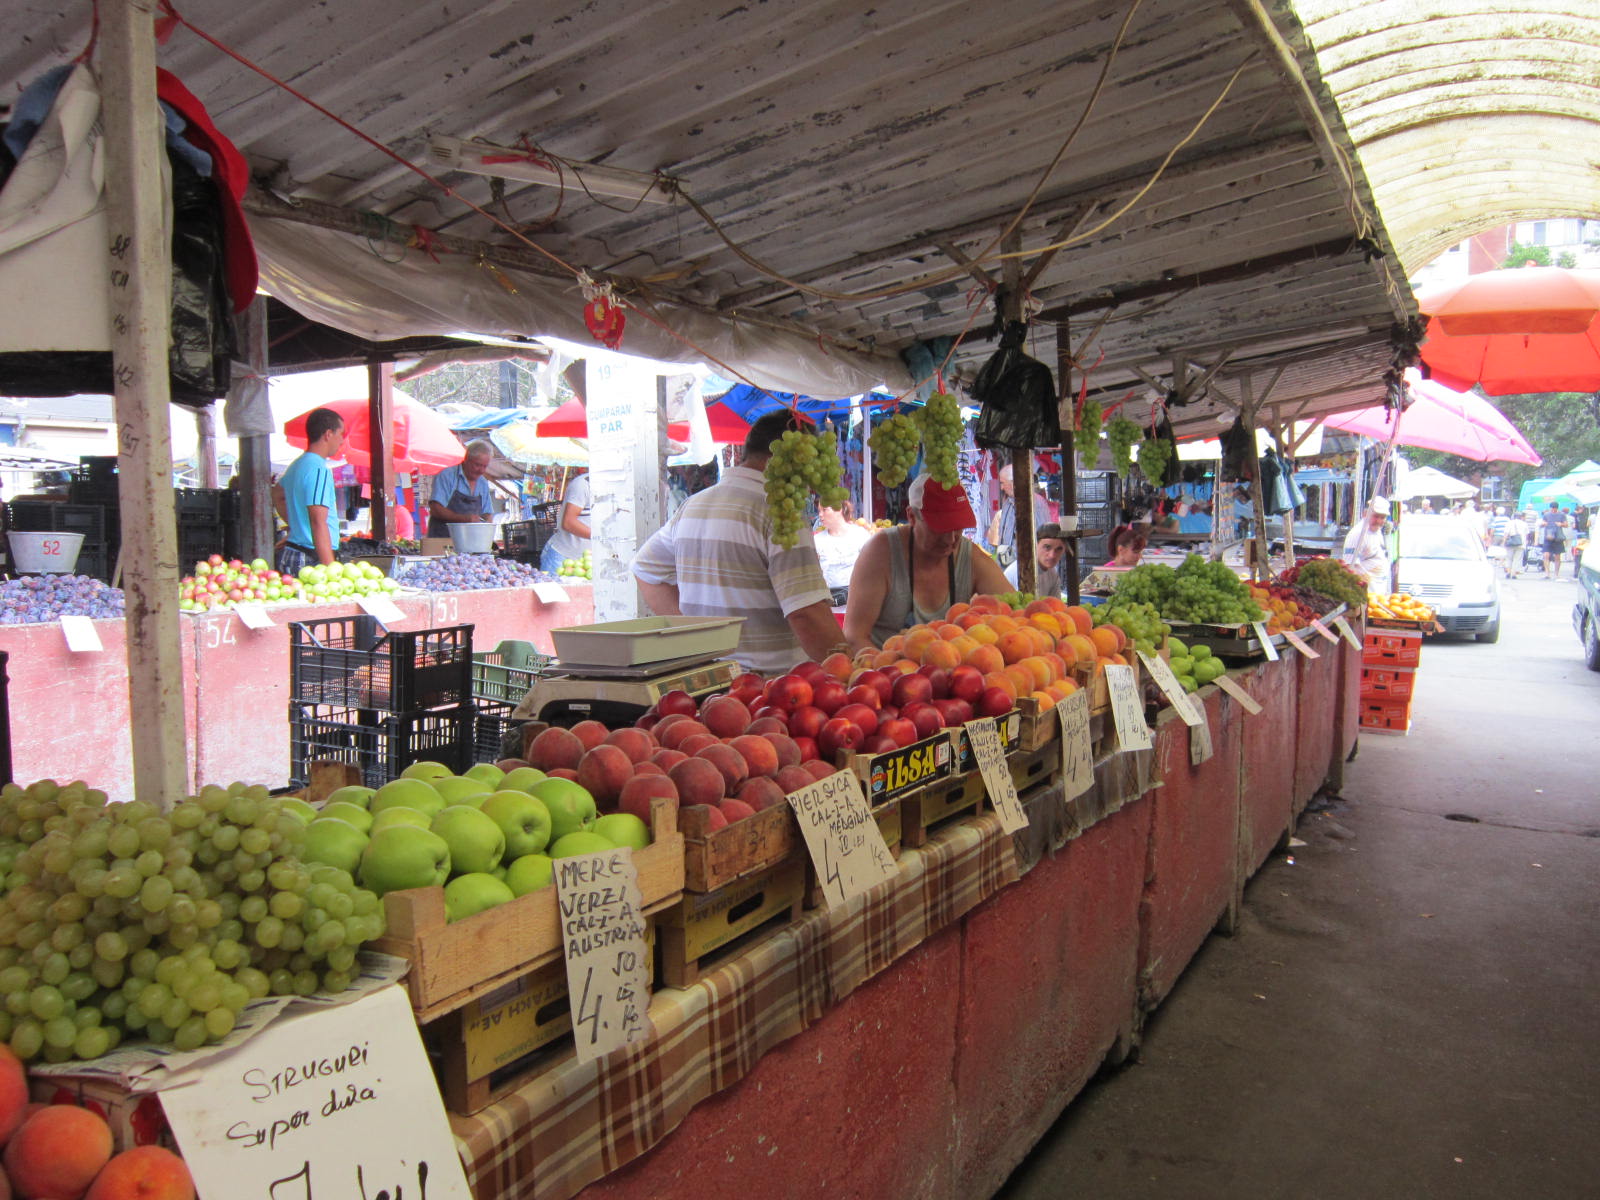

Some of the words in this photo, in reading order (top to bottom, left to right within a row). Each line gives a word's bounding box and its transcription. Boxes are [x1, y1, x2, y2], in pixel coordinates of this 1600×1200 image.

[600, 420, 623, 433] PAR
[42, 540, 61, 556] 52
[437, 597, 459, 623] 53
[207, 618, 236, 648] 54
[989, 771, 1009, 821] 4
